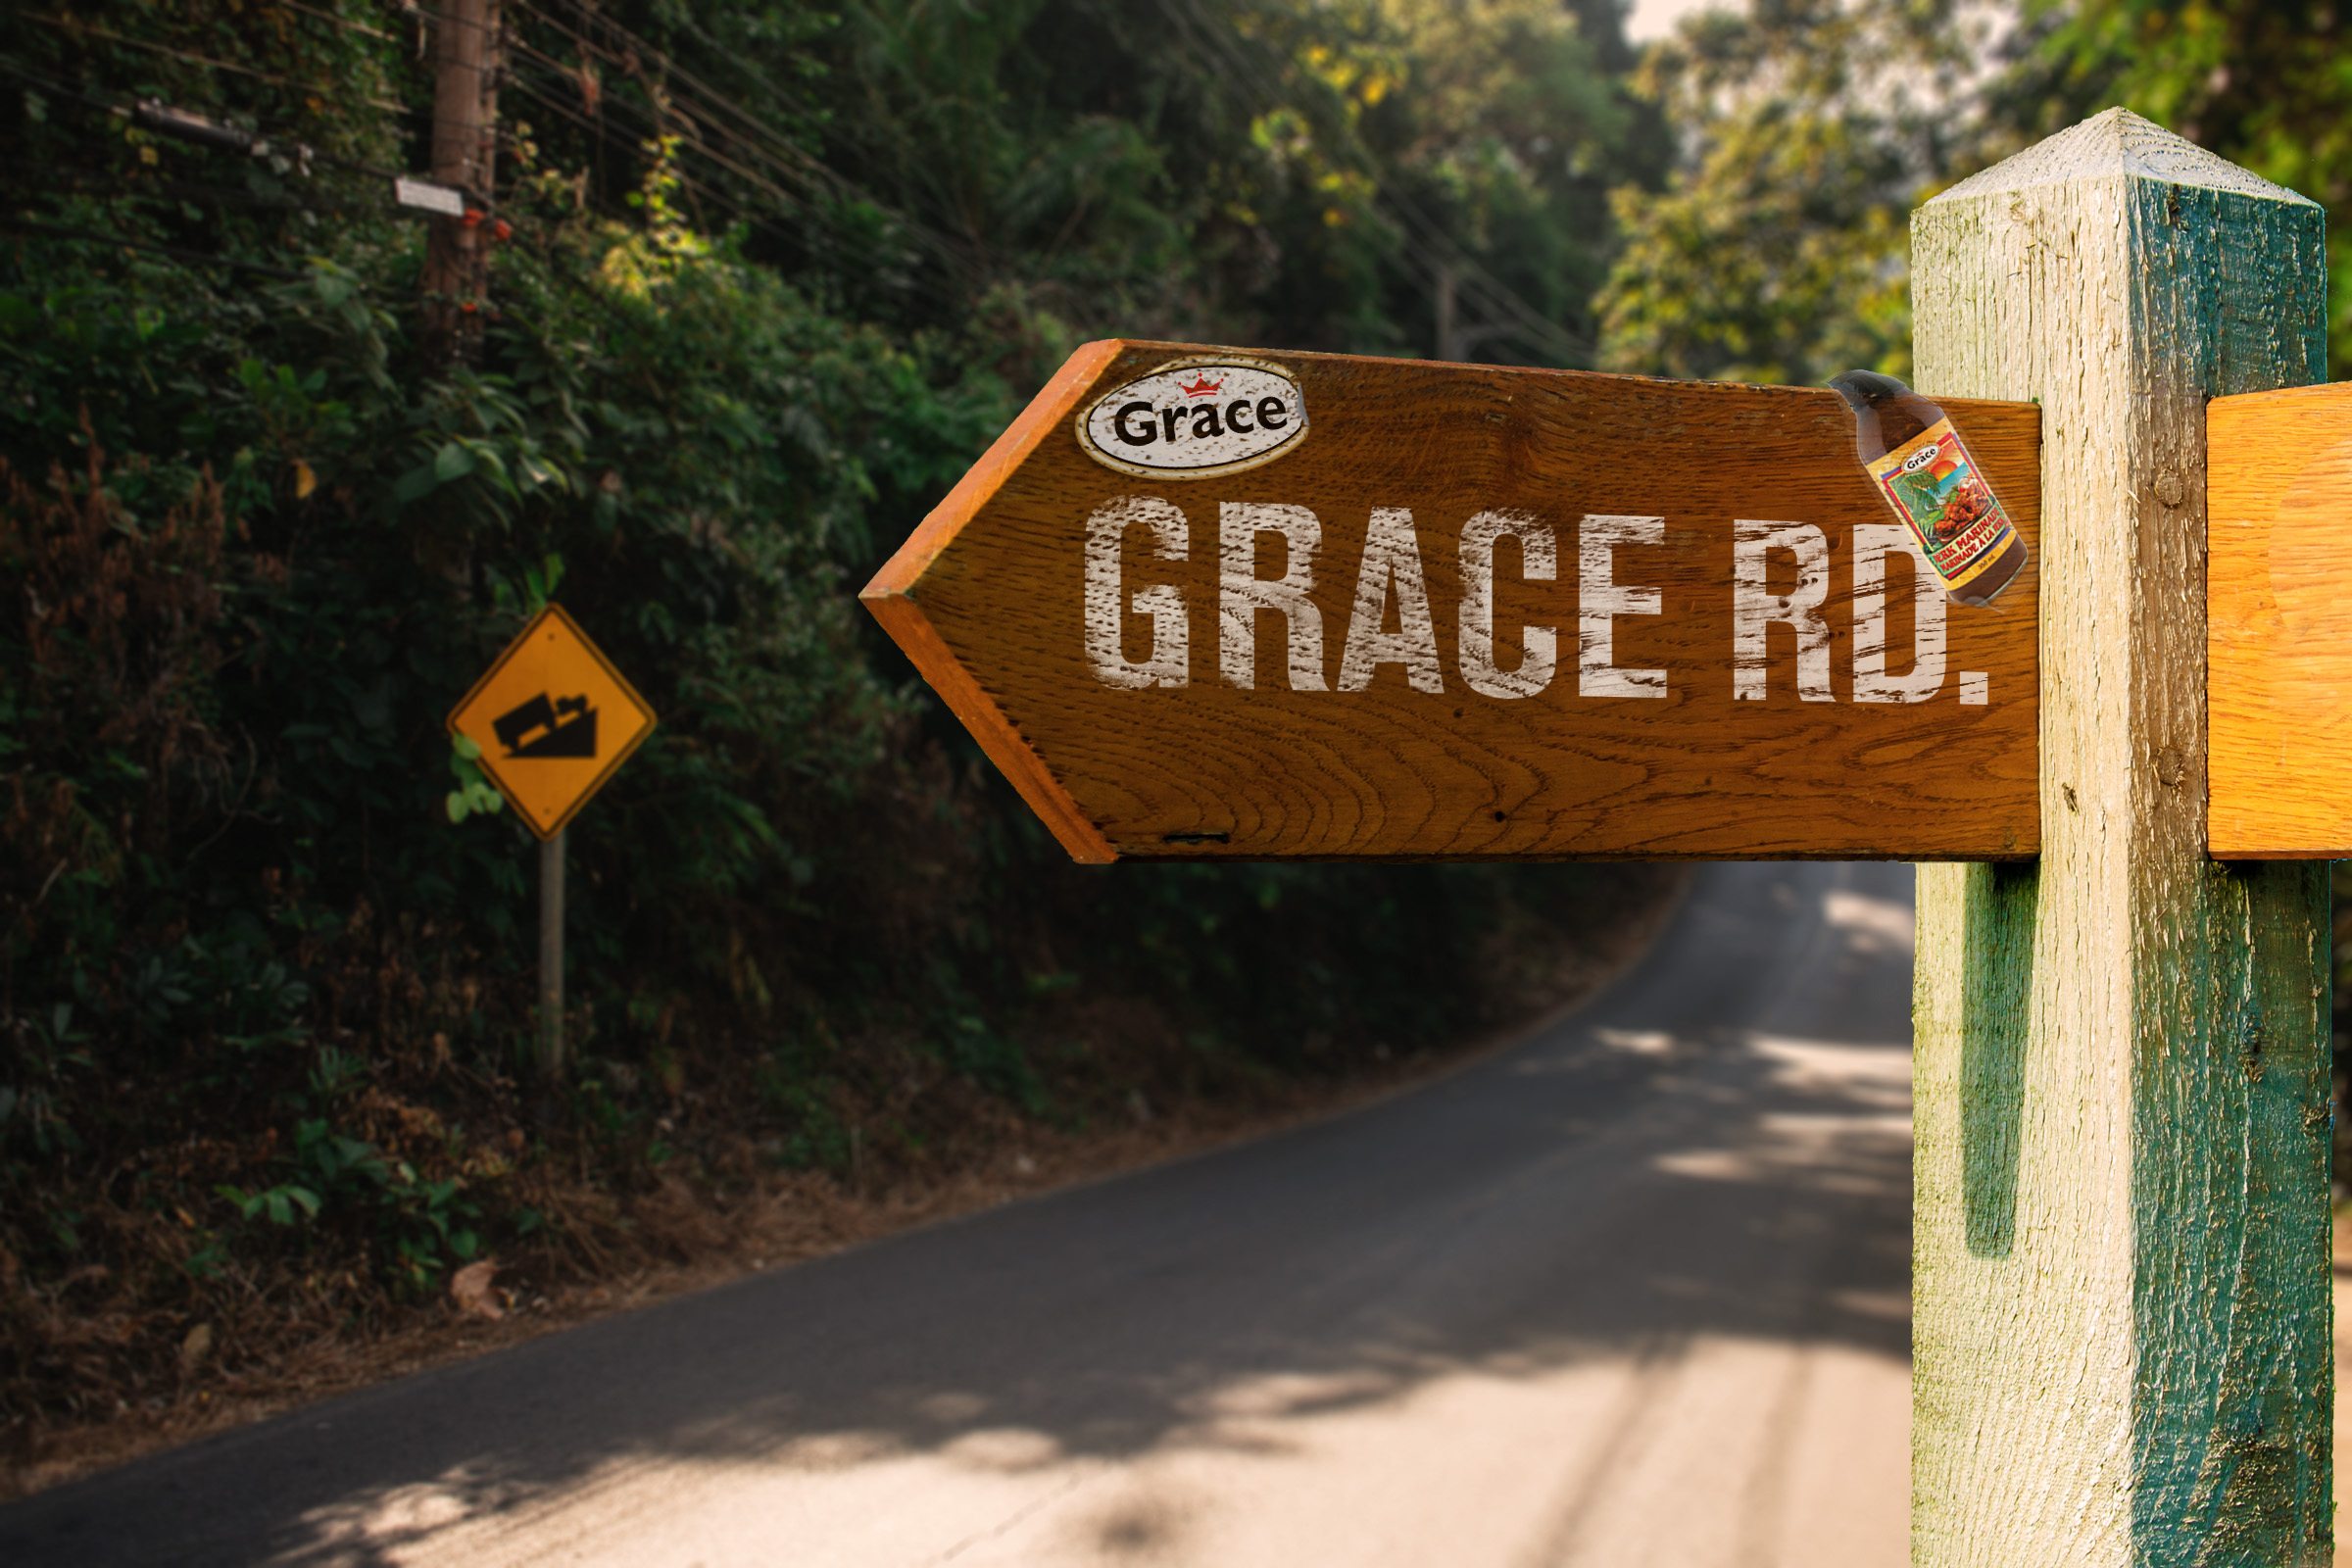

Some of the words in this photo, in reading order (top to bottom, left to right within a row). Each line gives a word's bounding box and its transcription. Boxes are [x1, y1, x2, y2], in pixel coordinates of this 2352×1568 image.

[1114, 393, 1288, 447] Grace
[1907, 448, 1936, 469] Grace
[1955, 507, 2000, 549] MARINADE
[1084, 494, 1667, 699] GRACE
[1734, 518, 1988, 705] RD.
